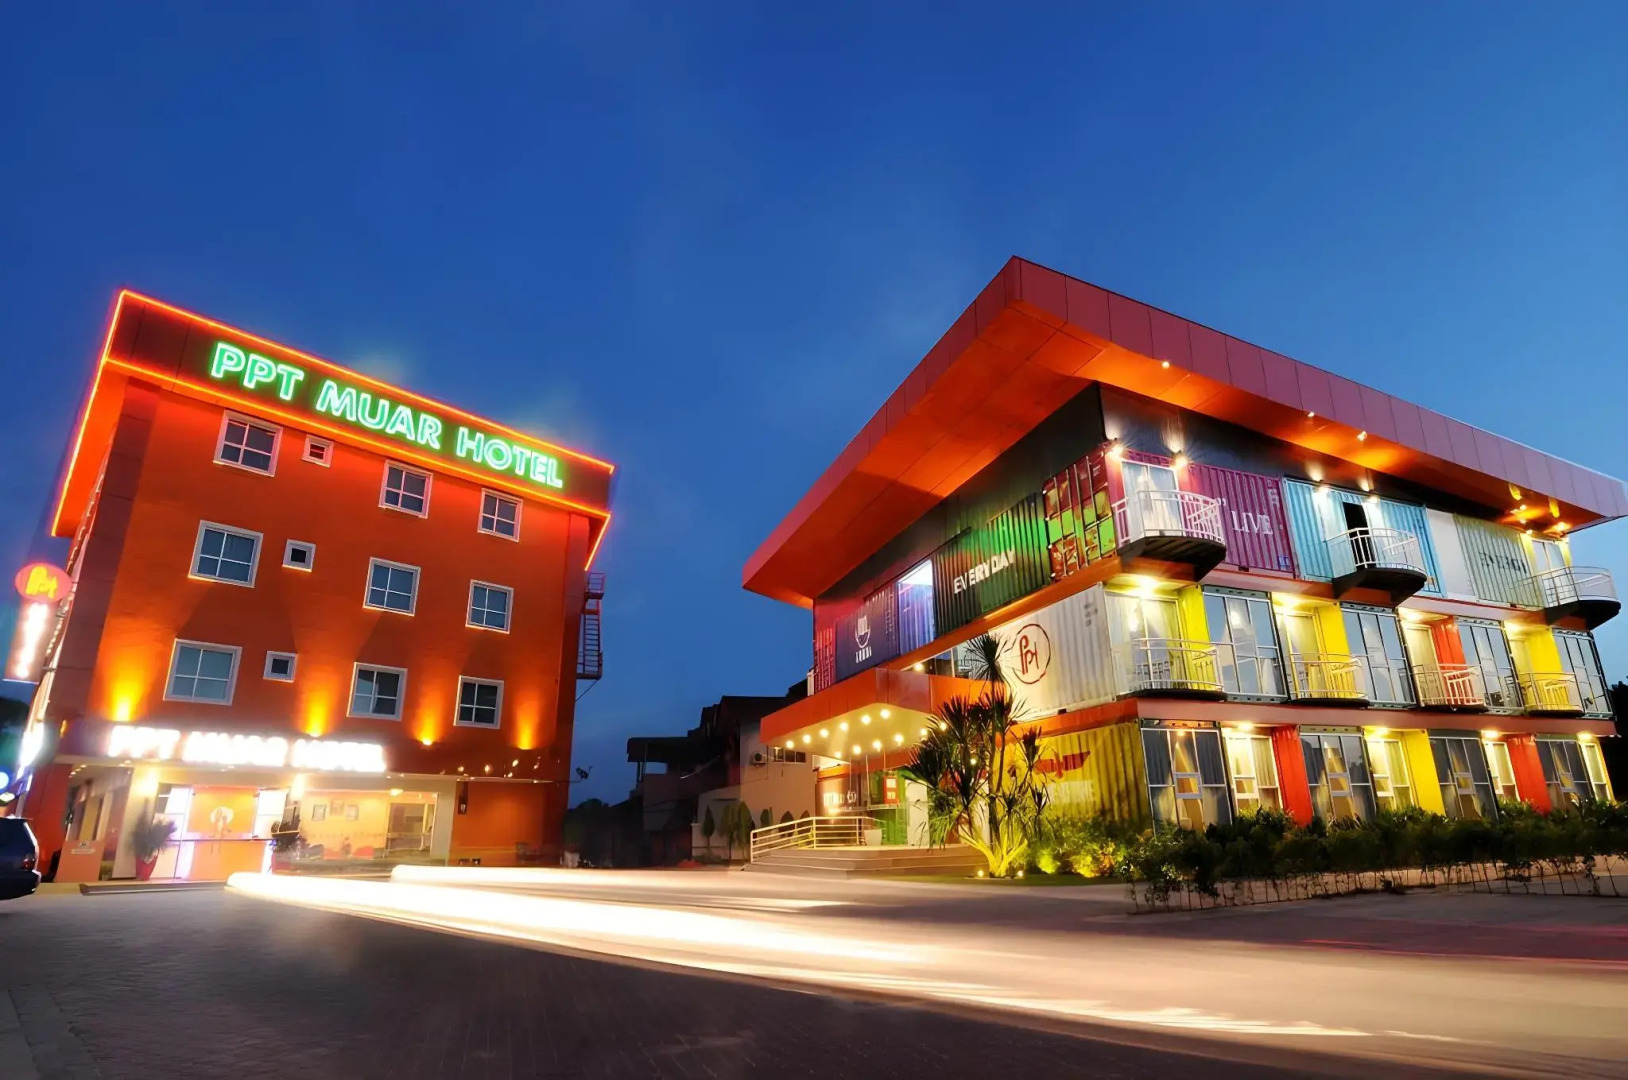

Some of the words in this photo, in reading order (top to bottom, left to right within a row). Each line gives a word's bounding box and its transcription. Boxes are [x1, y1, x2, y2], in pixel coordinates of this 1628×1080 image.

[210, 342, 304, 401] PPT
[315, 379, 442, 449] MUAR
[456, 426, 563, 489] HOTEL
[1230, 510, 1274, 535] LIVE
[953, 546, 1015, 594] EVERYDAY
